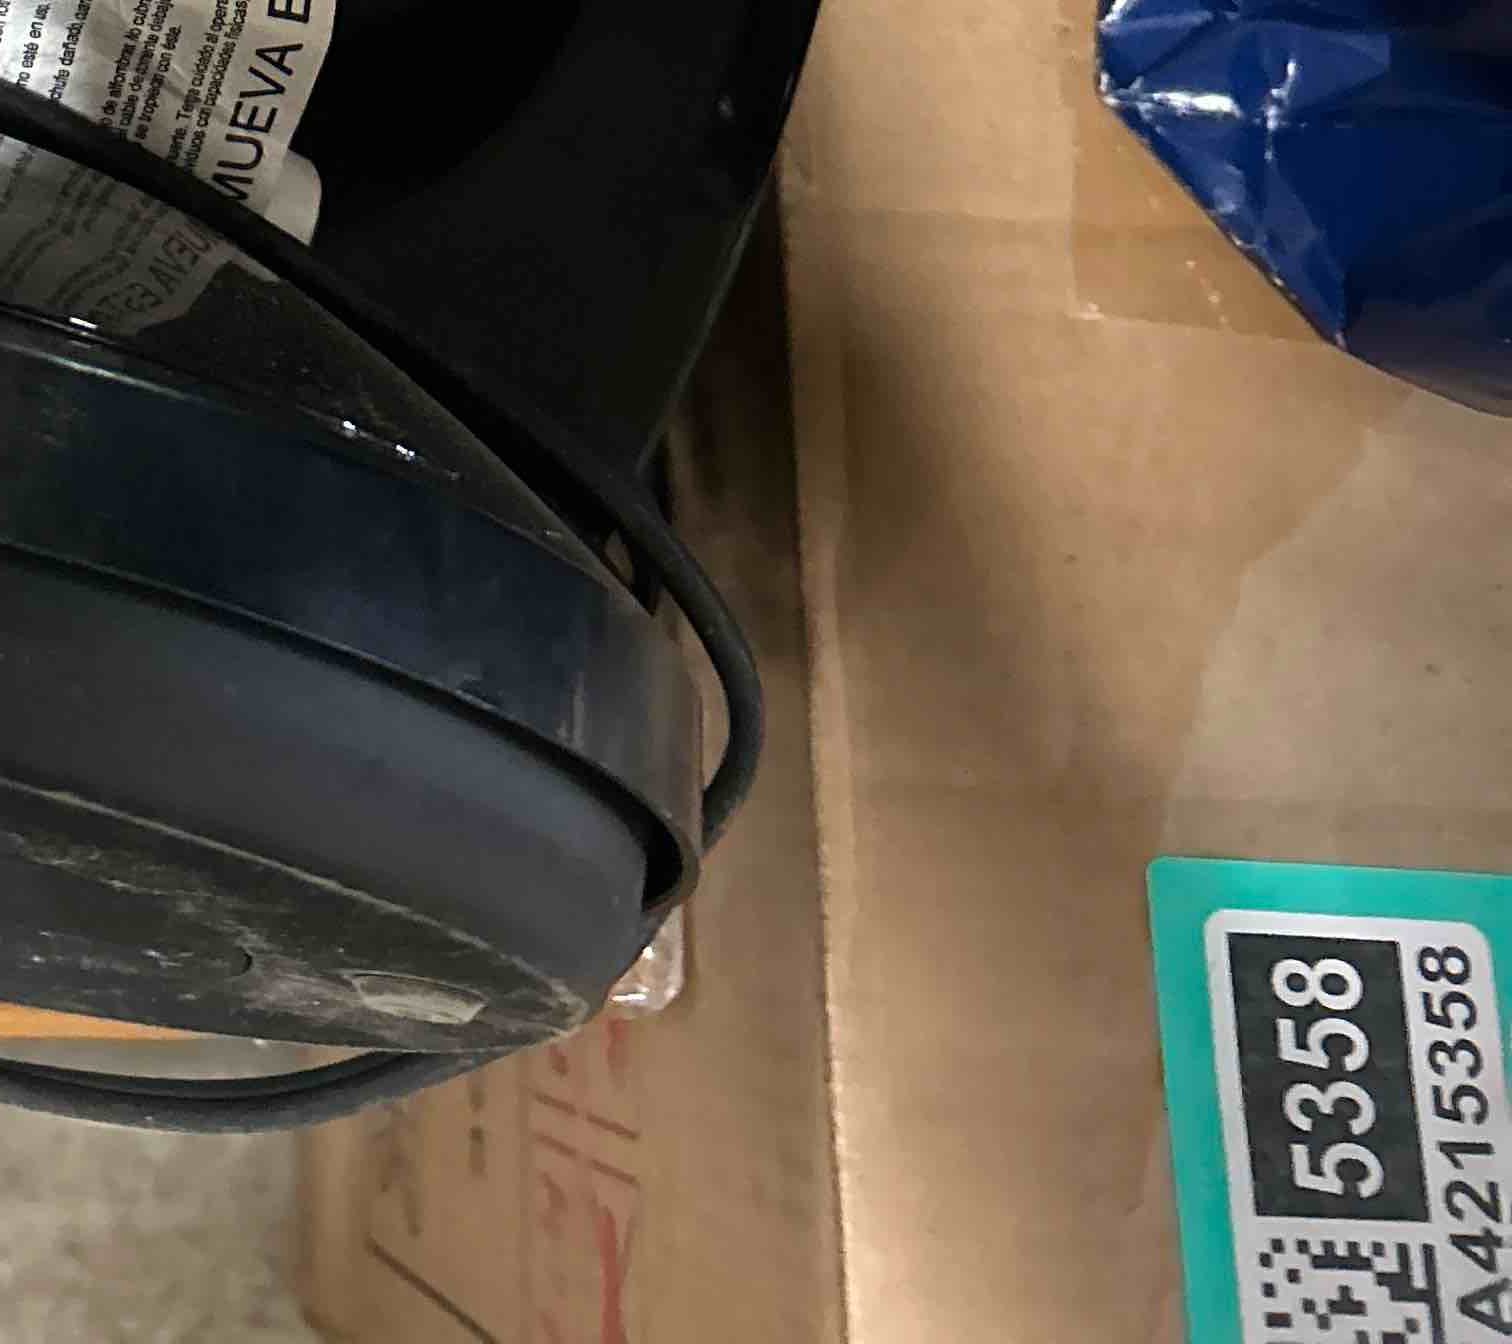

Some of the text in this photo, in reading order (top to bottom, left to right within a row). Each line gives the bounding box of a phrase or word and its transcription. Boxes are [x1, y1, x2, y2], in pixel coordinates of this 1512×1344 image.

[19, 21, 43, 69] esté en
[1269, 956, 1386, 1201] 5358
[1416, 944, 1512, 1337] A4215358
